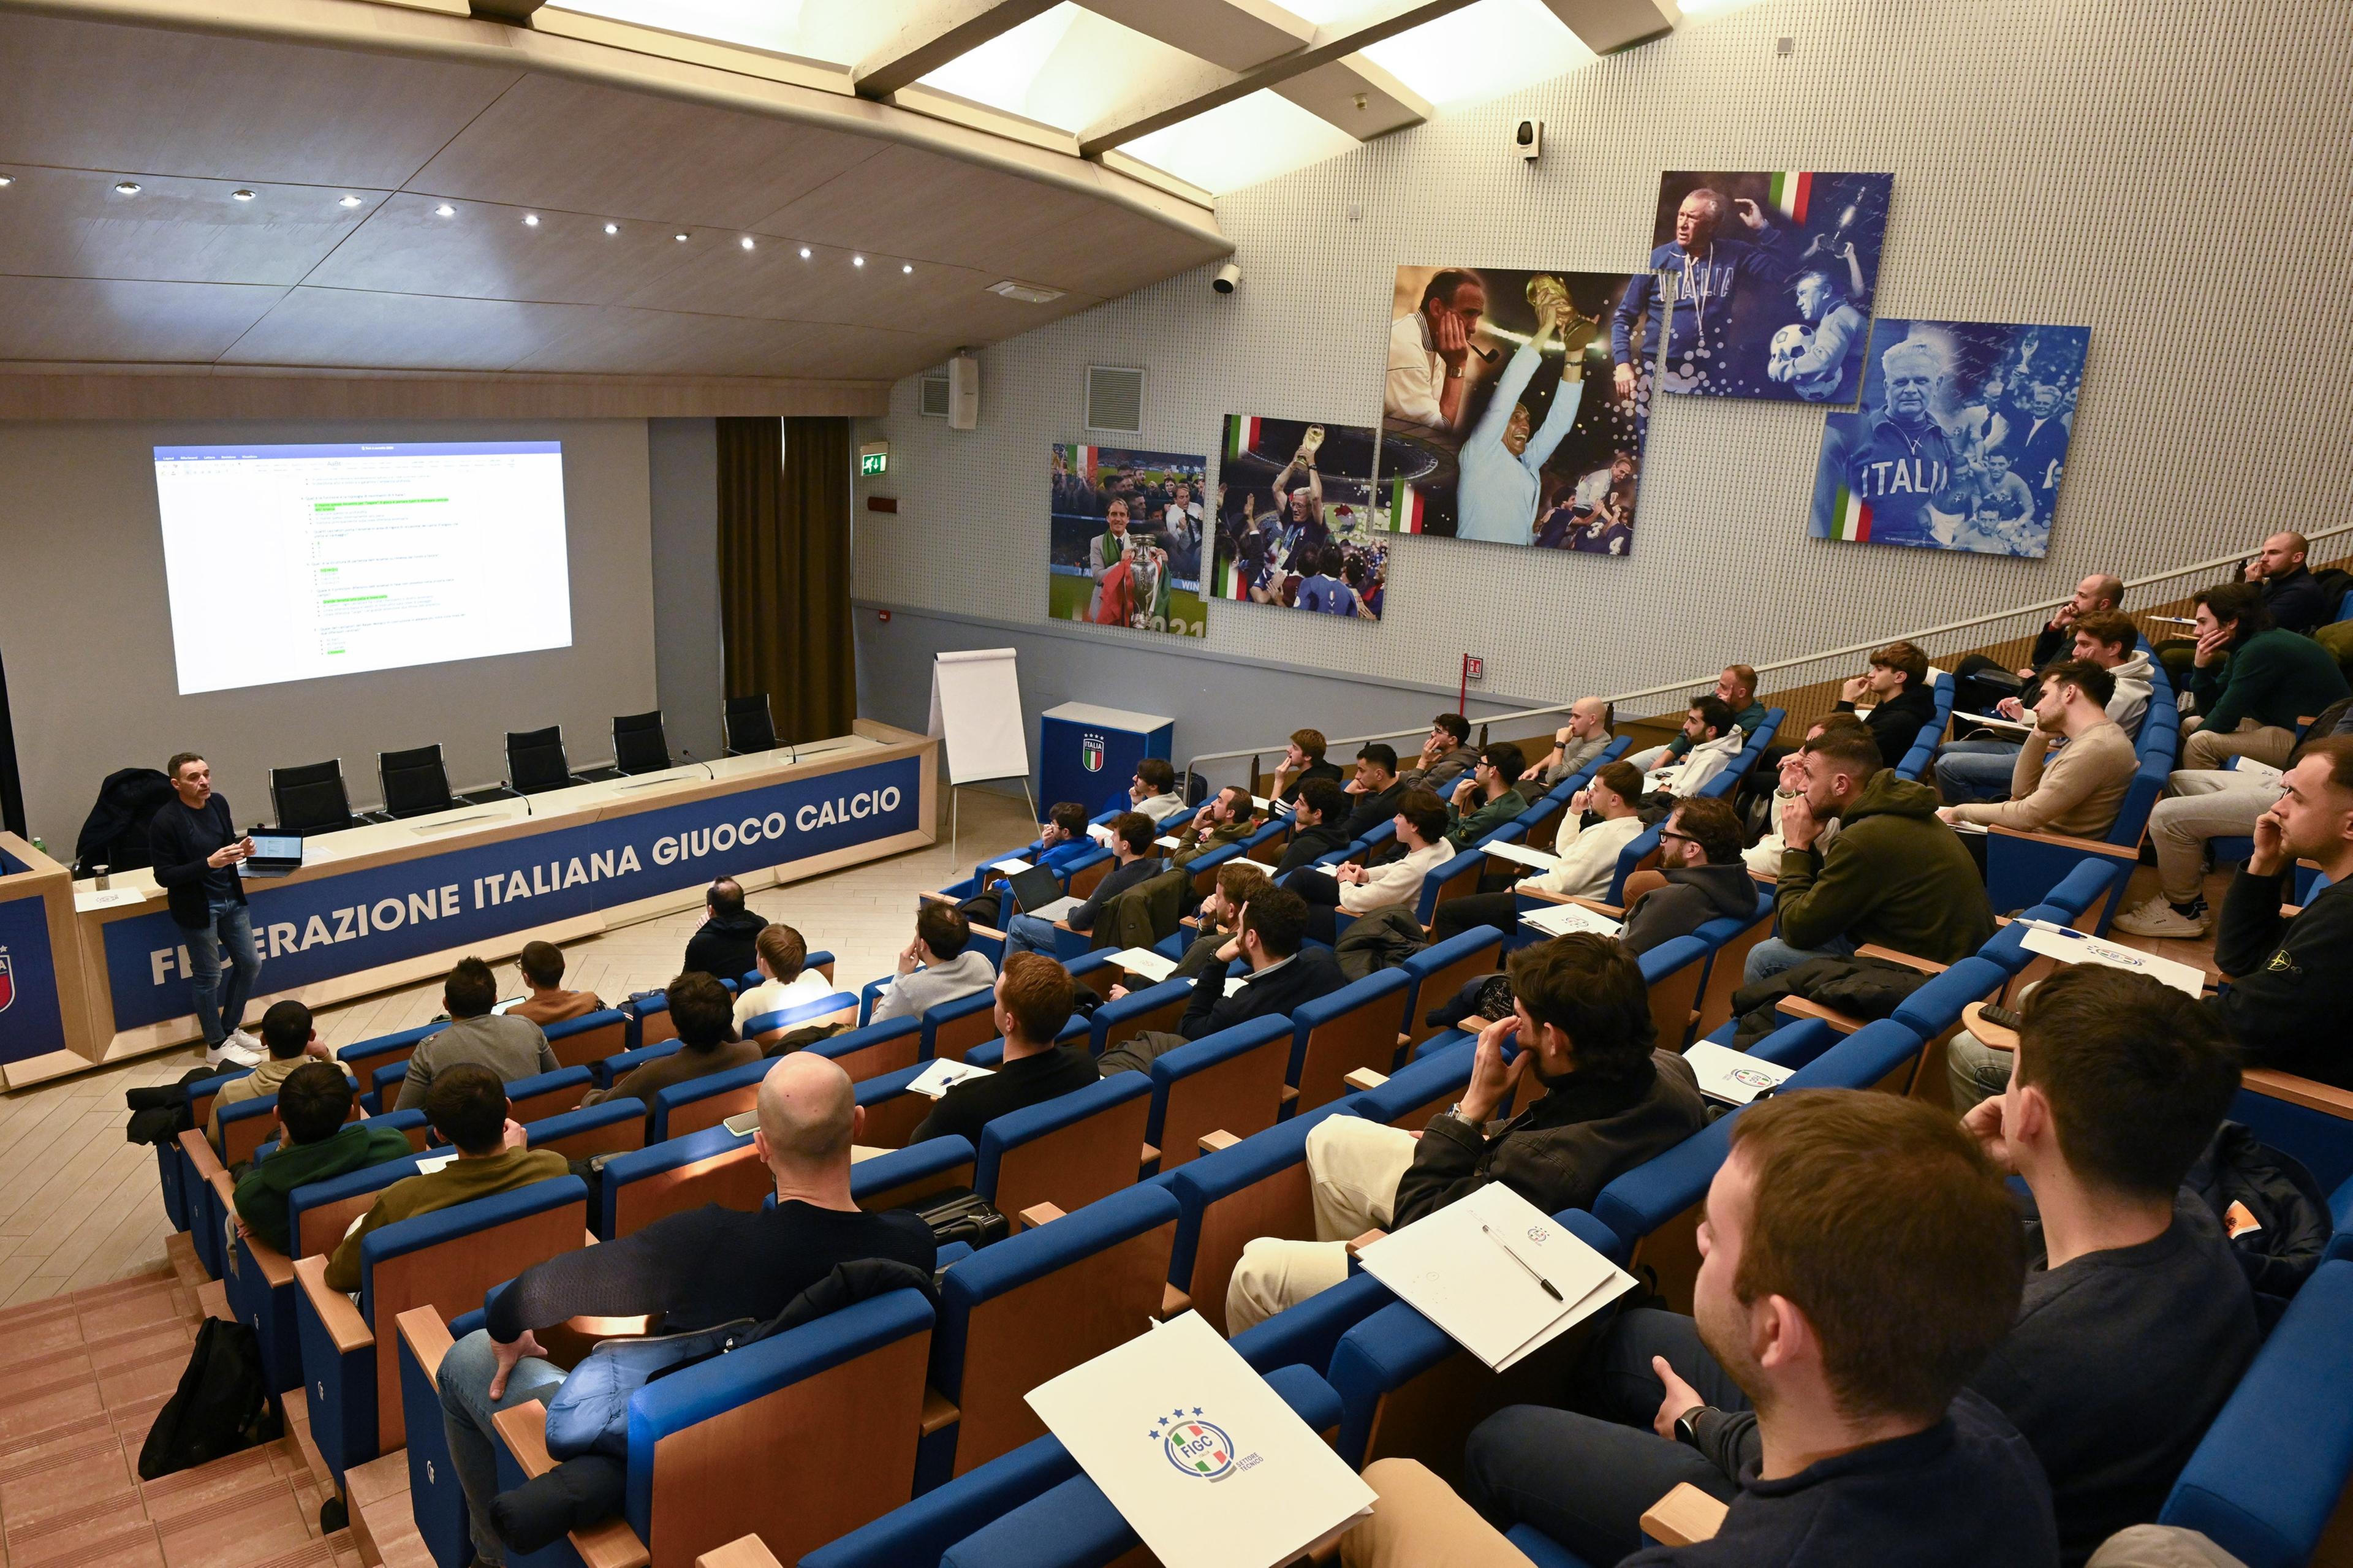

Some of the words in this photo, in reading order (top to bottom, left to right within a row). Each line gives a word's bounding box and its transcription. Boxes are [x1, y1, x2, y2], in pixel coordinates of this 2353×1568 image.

[1586, 521, 1604, 539] 3
[1085, 741, 1102, 749] ITALIA
[474, 844, 642, 910] ITALIANA
[651, 812, 786, 866] GIUOCO
[795, 786, 901, 832] CALCIO
[1181, 1436, 1213, 1458] FIGC
[1235, 1452, 1259, 1468] SETTORE
[1240, 1456, 1264, 1472] TECNICO
